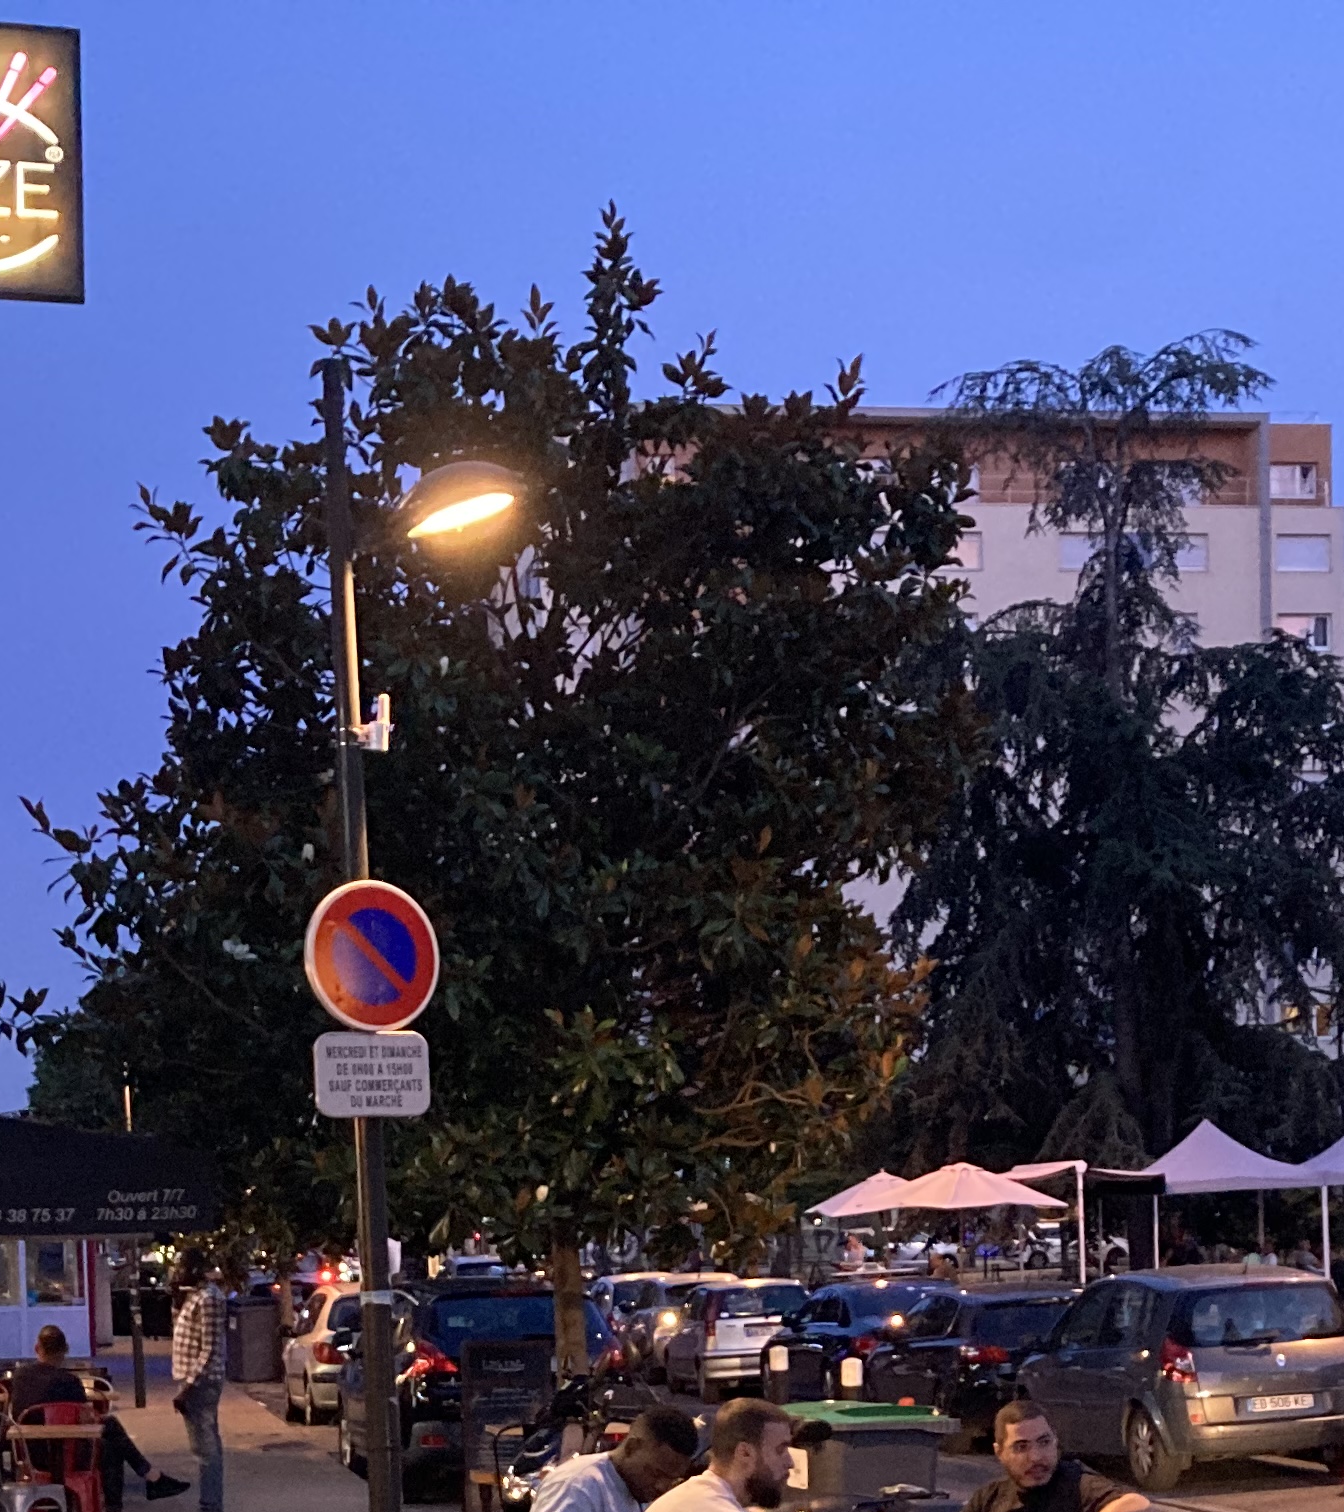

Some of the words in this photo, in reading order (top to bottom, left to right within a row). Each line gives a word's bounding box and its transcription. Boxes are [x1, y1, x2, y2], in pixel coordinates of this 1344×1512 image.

[325, 1045, 367, 1059] MERCREDI
[369, 1045, 379, 1058] ET
[381, 1045, 422, 1058] DIMANCHE
[336, 1063, 348, 1075] DE
[328, 1079, 352, 1092] SAUF
[350, 1095, 362, 1107] DU
[107, 1189, 158, 1203] Ouvert
[162, 1188, 185, 1203] 7/7
[6, 1208, 27, 1222] 38
[31, 1207, 51, 1222] 75
[55, 1207, 76, 1222] 37
[96, 1207, 134, 1221] 7h30
[150, 1204, 197, 1220] 23h30
